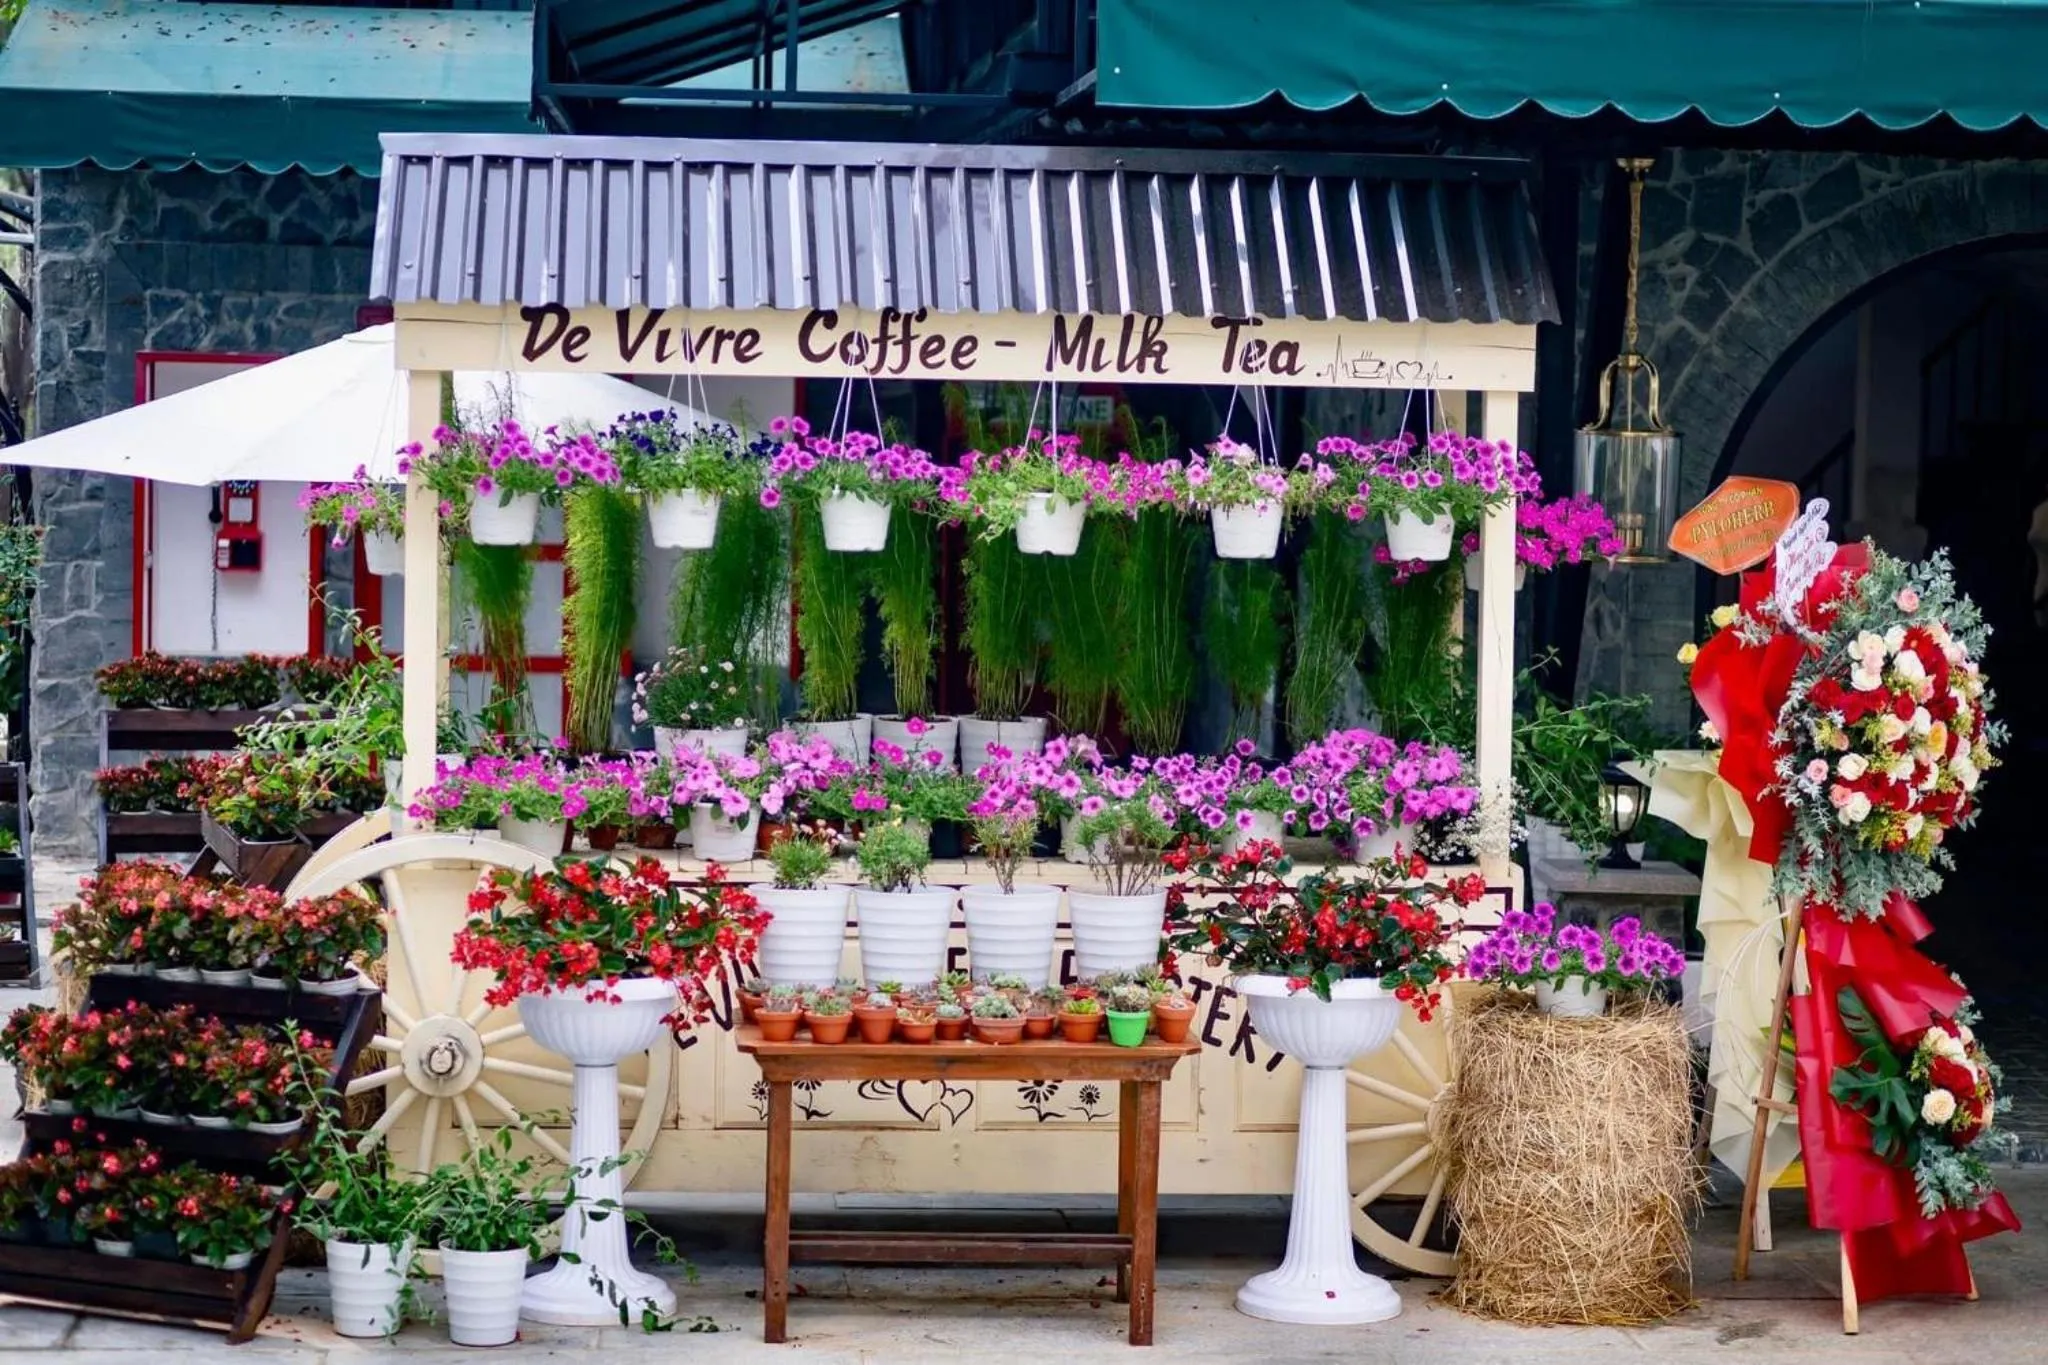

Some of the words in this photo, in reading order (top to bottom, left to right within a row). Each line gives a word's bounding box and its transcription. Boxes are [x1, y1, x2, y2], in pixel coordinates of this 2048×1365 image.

[520, 303, 591, 363] De
[616, 308, 763, 364] Vivre
[798, 306, 979, 375] Coffee
[1045, 313, 1169, 374] Milk
[1211, 315, 1306, 376] Tea
